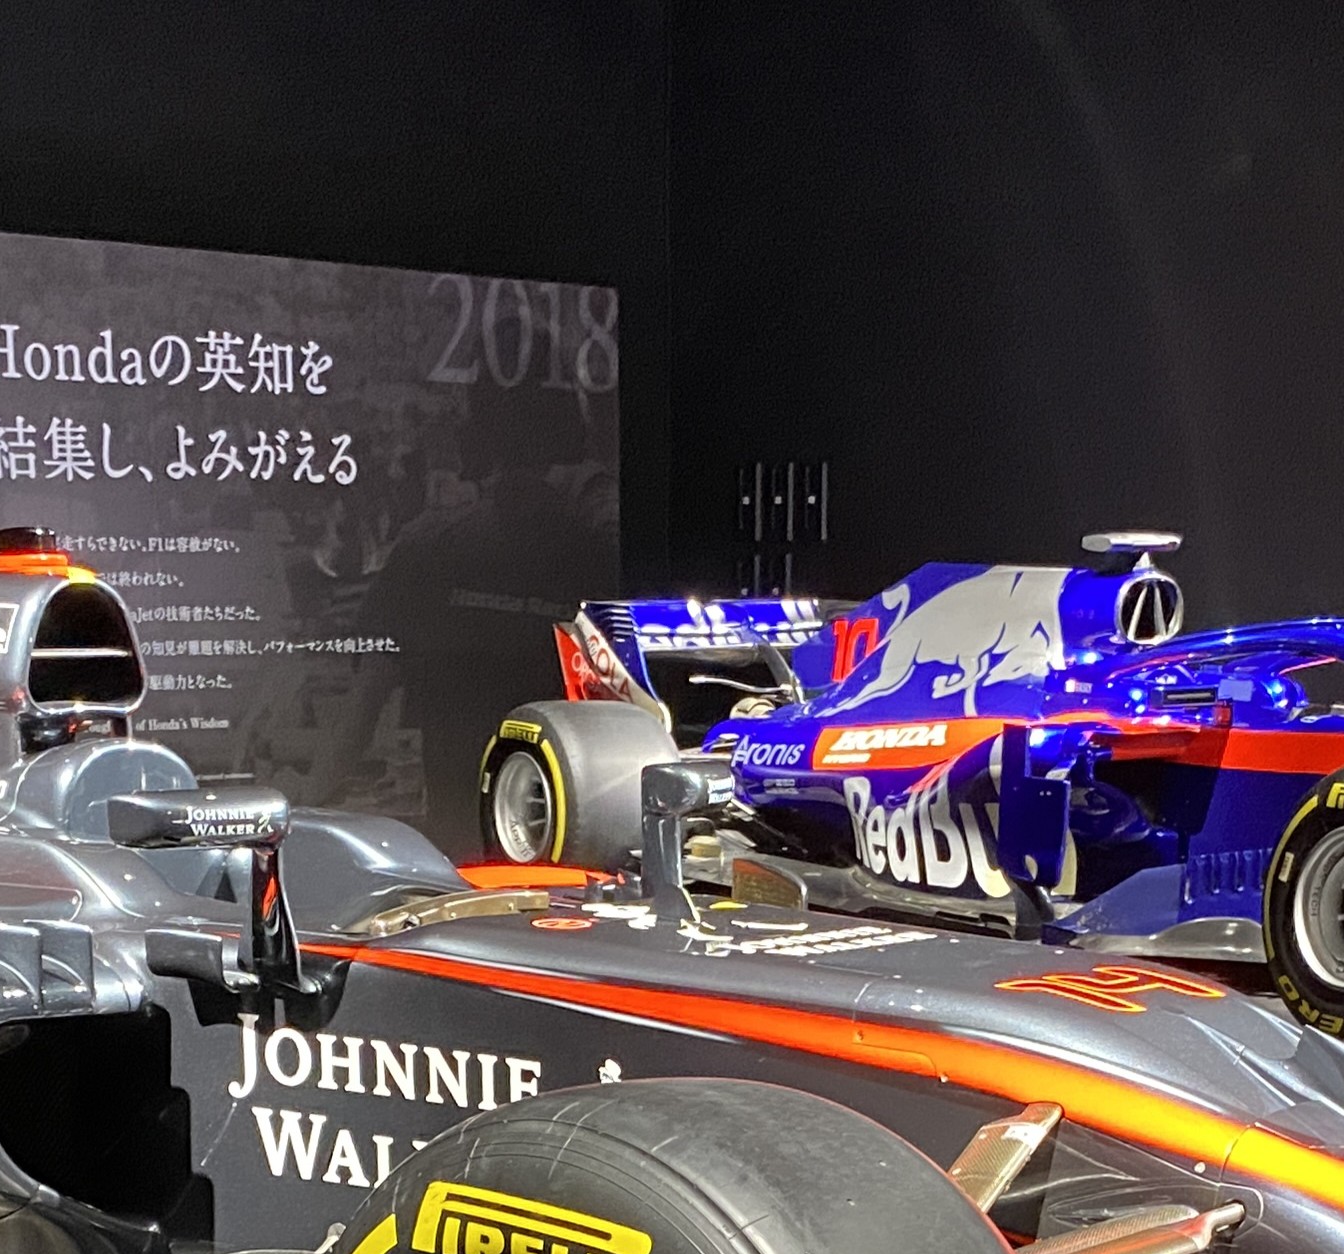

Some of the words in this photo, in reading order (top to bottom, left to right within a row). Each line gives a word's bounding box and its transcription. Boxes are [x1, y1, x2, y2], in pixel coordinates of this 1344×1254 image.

[427, 275, 619, 394] 2018
[830, 725, 948, 751] HONDA
[185, 805, 254, 824] JOHNNIE
[190, 823, 255, 836] WALKER
[227, 1013, 543, 1112] JOHNNIE
